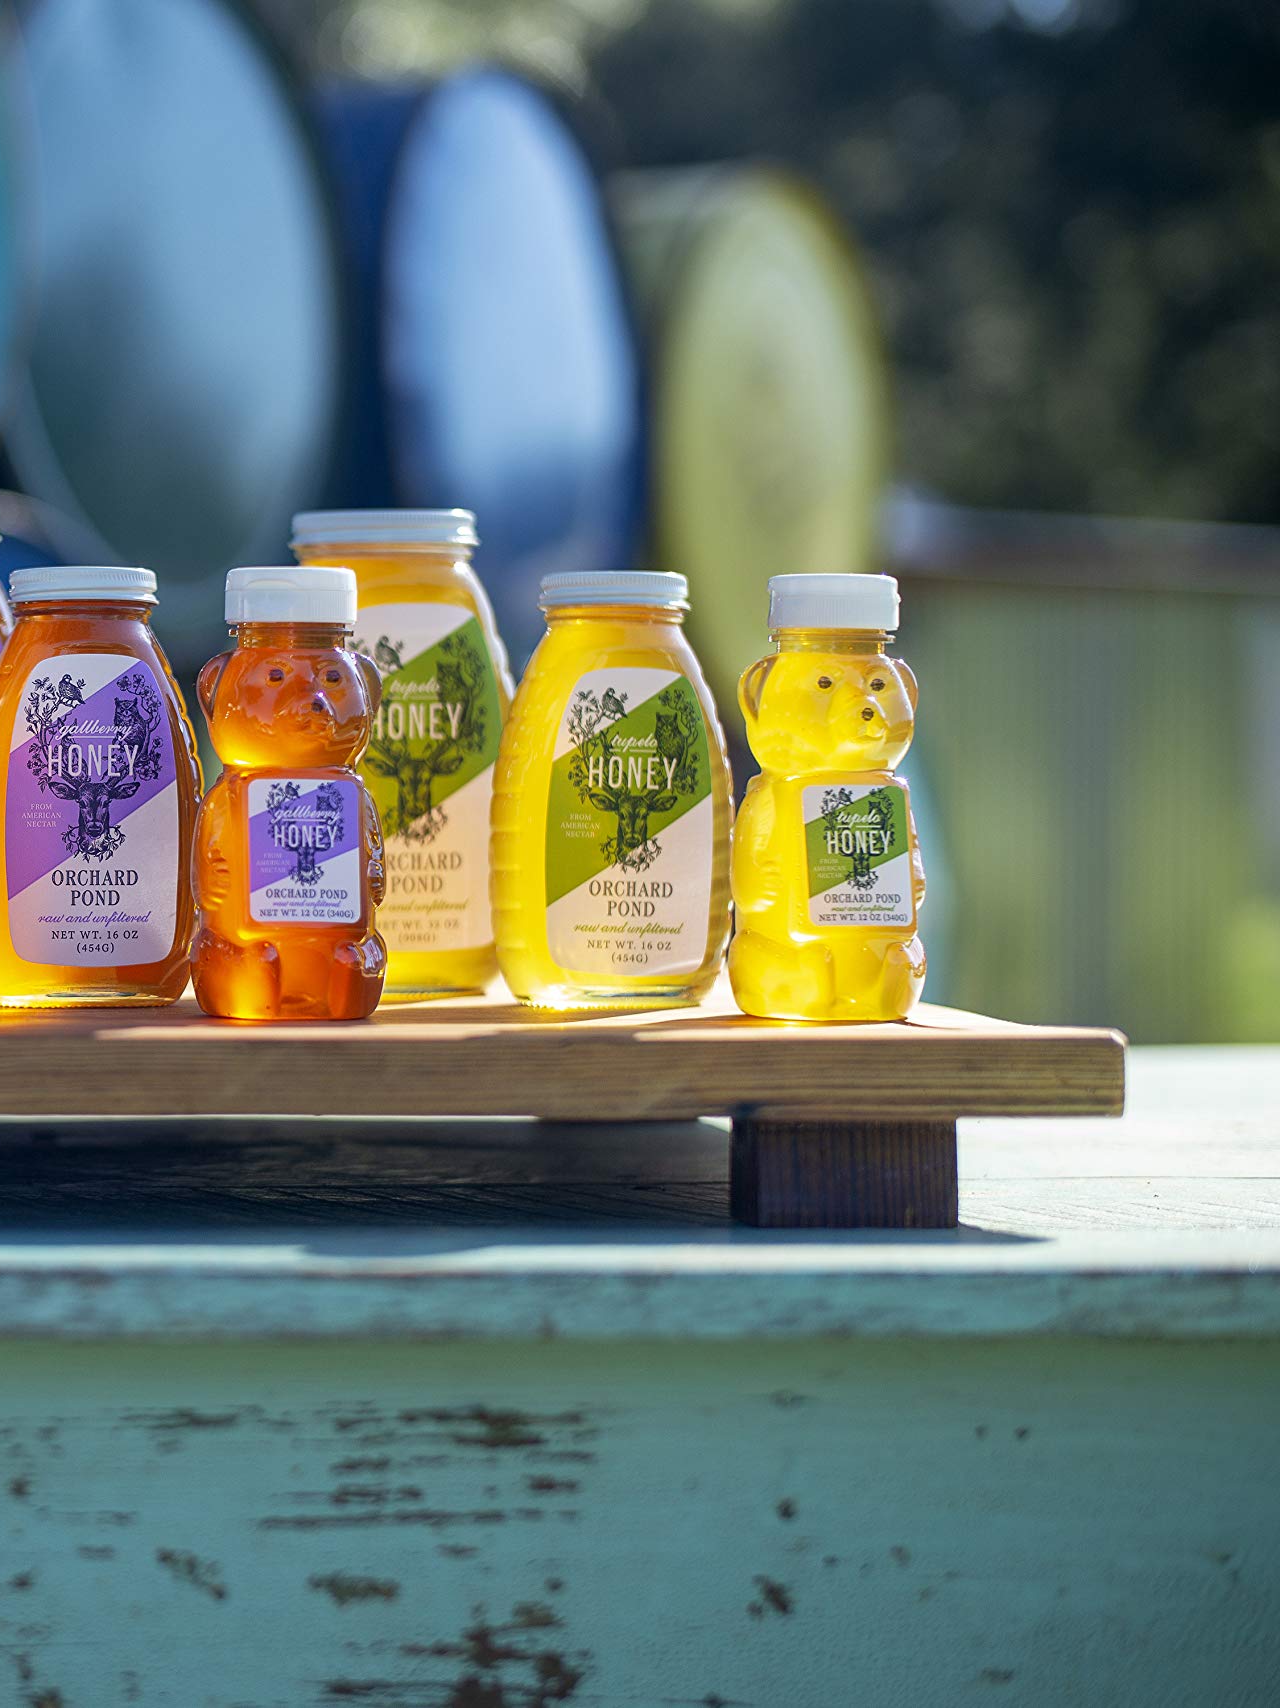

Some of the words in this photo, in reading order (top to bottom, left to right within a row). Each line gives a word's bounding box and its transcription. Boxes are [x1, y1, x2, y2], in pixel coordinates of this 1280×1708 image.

[55, 719, 133, 741] gallberry
[611, 733, 658, 753] tupelo
[47, 744, 139, 777] HONEY
[588, 756, 677, 790] HONEY
[21, 811, 62, 819] AMERICAN
[271, 805, 341, 824] gallberry
[569, 813, 592, 821] FROM
[836, 809, 881, 827] tupelo
[26, 820, 57, 828] NECTAR
[560, 822, 601, 830] AMERICAN
[274, 825, 338, 848] HONEY
[565, 830, 595, 838] NECTAR
[827, 829, 891, 855] HONEY
[386, 852, 463, 872] RCHARD
[51, 869, 139, 886] ORCHARD
[391, 876, 444, 895] POND
[265, 888, 317, 899] ORCHARD
[320, 889, 348, 899] POND
[588, 880, 674, 898] ORCHARD
[70, 889, 121, 906] POND
[824, 893, 873, 904] ORCHARD
[876, 894, 902, 904] POND
[260, 909, 278, 917] NET
[281, 909, 298, 918] WT.
[301, 909, 310, 917] 12
[312, 909, 325, 917] OZ
[327, 909, 355, 920] (340G)
[607, 900, 656, 918] POND
[38, 912, 65, 923] raw
[65, 911, 94, 923] and
[92, 911, 152, 927] unfiltered
[444, 919, 459, 929] OZ
[819, 913, 838, 922] NET
[839, 914, 857, 922] WT.
[859, 914, 869, 922] 12
[870, 914, 882, 922] OZ
[883, 914, 908, 923] (340G)
[51, 930, 75, 939] NET
[79, 930, 102, 939] WT.
[107, 930, 119, 939] 16
[123, 930, 139, 939] OZ
[573, 923, 600, 933] raw
[601, 921, 629, 934] and
[626, 922, 685, 938] unfiltered
[76, 942, 115, 954] (454G)
[587, 940, 611, 949] NET
[615, 940, 637, 950] WT.
[641, 941, 653, 950] 16
[657, 941, 672, 950] OZ
[611, 952, 649, 964] (454G)
